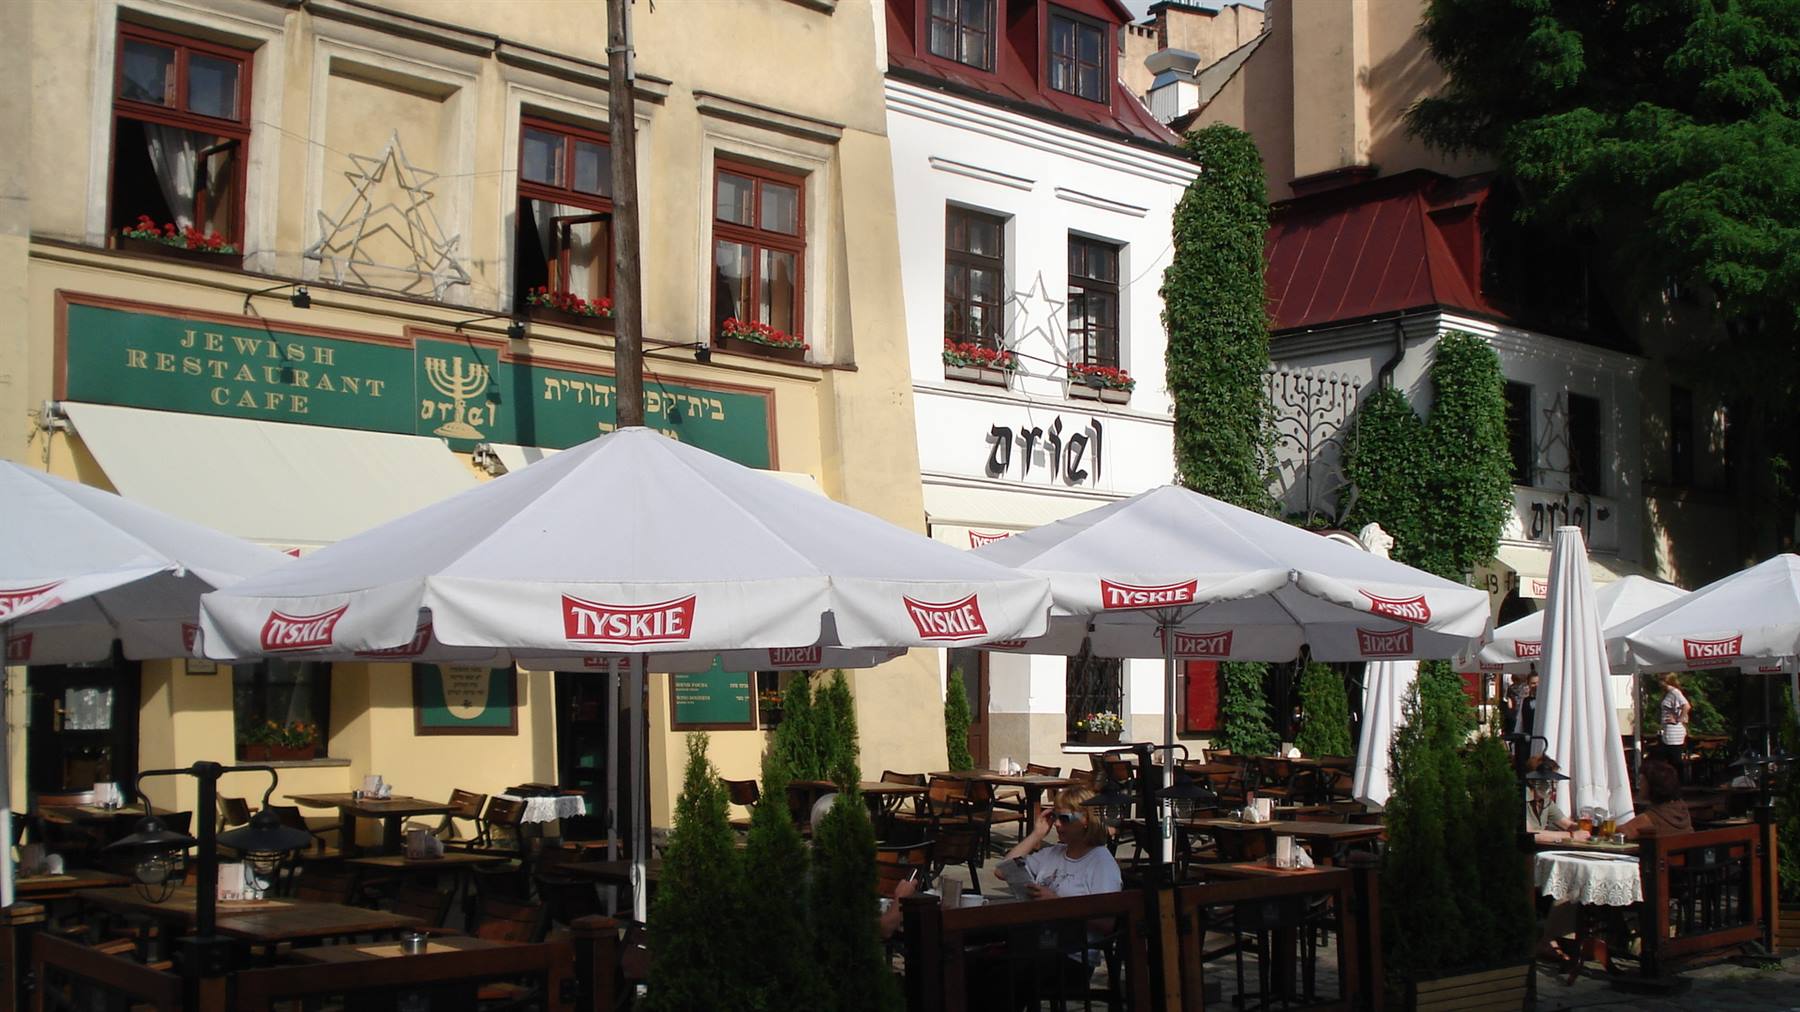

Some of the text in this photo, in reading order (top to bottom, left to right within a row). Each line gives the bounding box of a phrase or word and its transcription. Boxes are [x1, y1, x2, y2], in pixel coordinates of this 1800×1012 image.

[180, 329, 335, 366] JEWISH
[126, 348, 385, 398] RESTAURANT
[211, 386, 309, 414] CAFE
[990, 414, 1103, 484] ariel
[1107, 587, 1189, 605] TYSKIE
[1375, 601, 1429, 620] YSKIE
[266, 613, 339, 645] TYSKIE
[571, 605, 686, 638] TYSKIE
[911, 604, 982, 633] TYSKIE
[1517, 642, 1542, 656] TYSK
[1687, 640, 1739, 657] TYSKIE
